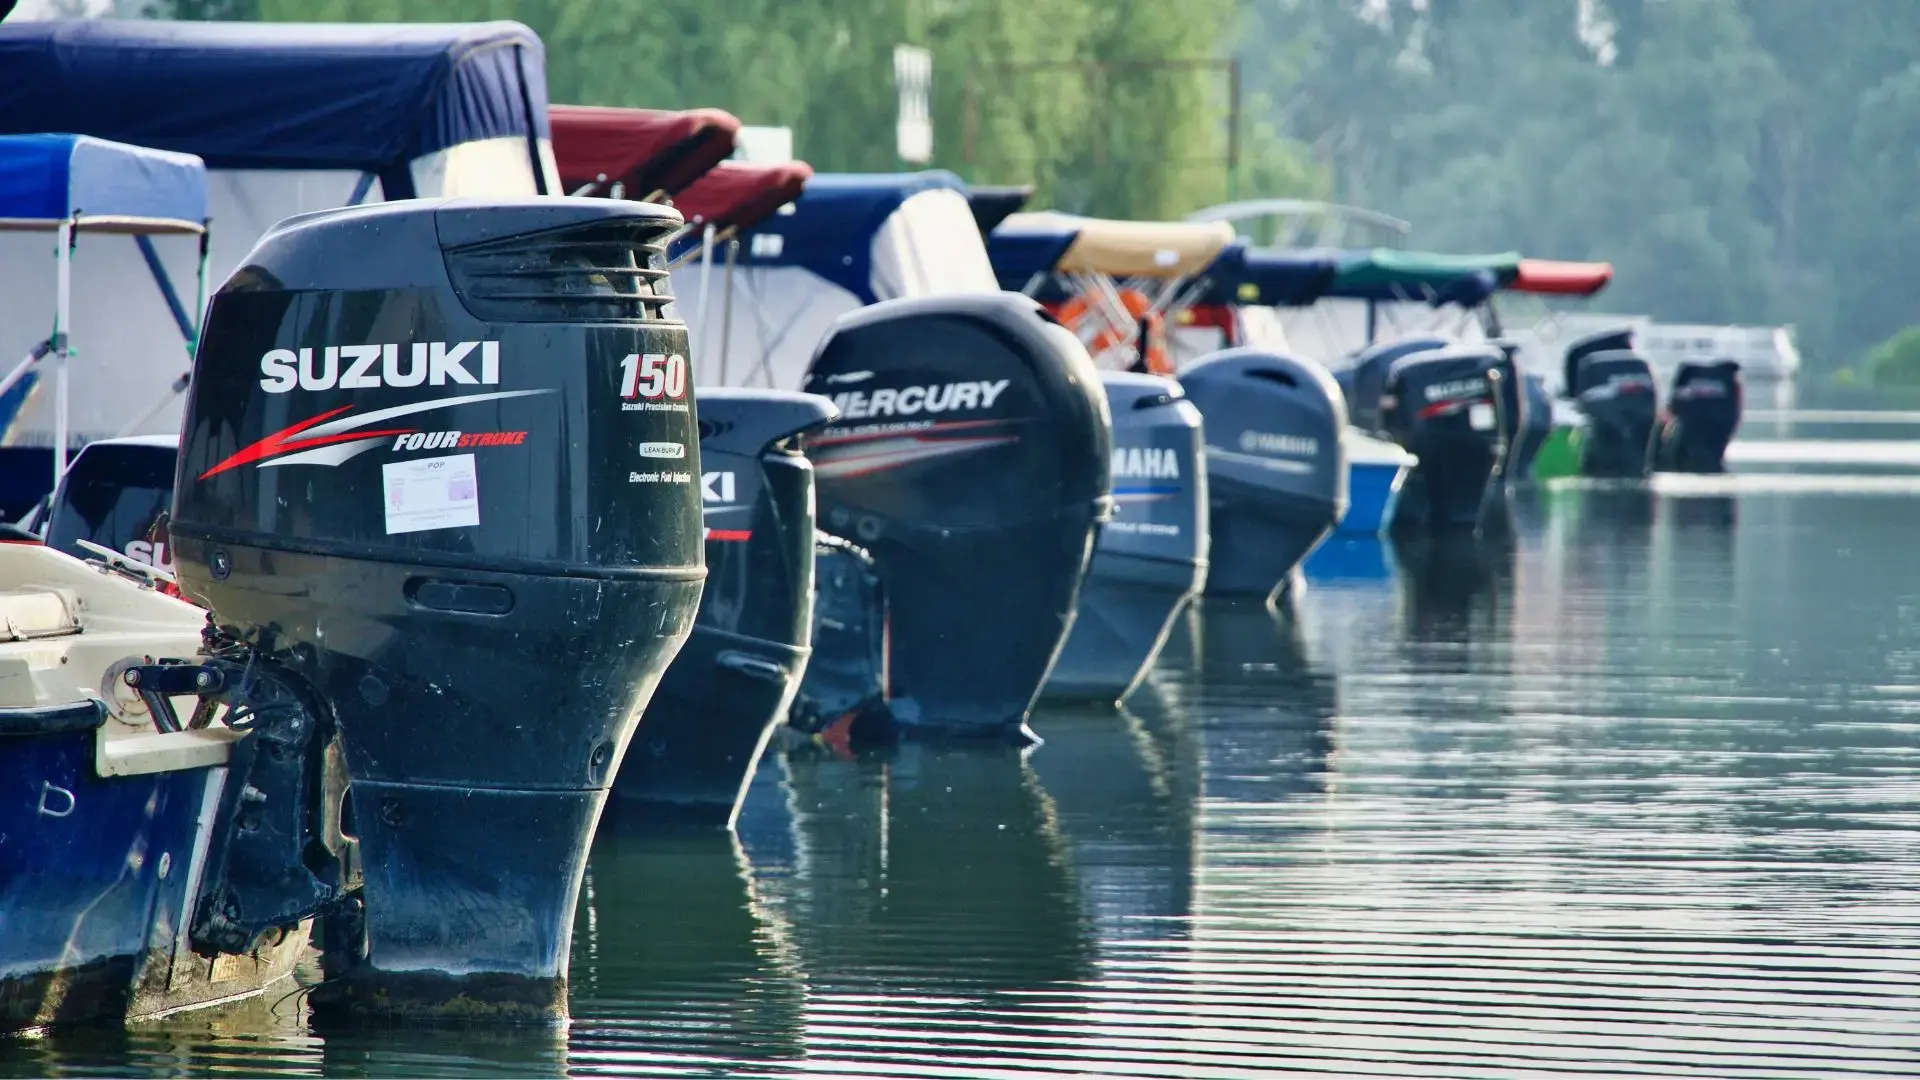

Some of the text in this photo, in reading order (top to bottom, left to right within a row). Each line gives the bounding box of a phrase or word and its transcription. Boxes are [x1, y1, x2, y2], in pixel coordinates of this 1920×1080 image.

[260, 341, 499, 393] SUZUKI
[620, 353, 687, 400] 150
[621, 402, 644, 411] Suzuki
[643, 446, 660, 454] LEAN
[1110, 447, 1180, 479] MAHA
[628, 471, 660, 482] Electronic
